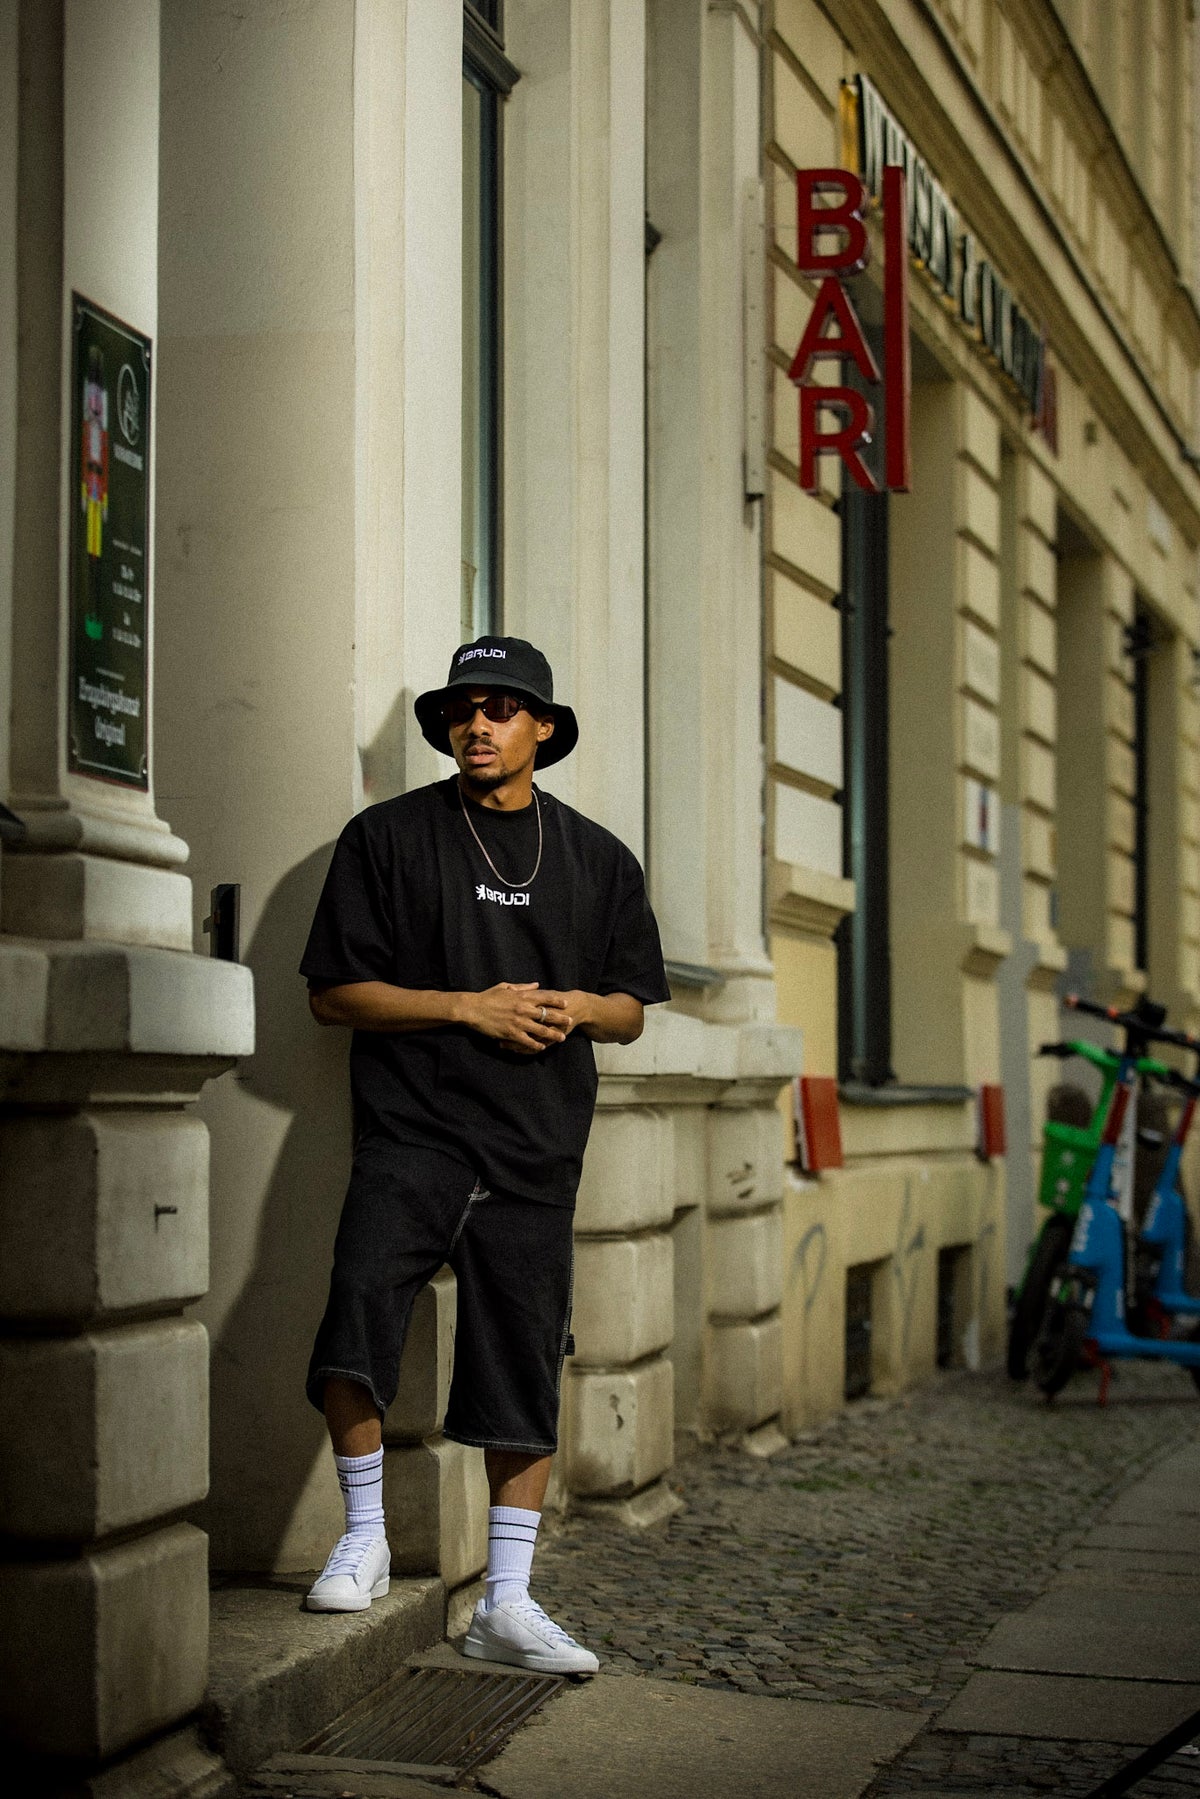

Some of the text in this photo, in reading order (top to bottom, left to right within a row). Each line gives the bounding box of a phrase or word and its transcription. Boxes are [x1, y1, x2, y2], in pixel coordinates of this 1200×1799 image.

[787, 168, 881, 495] BAR
[464, 648, 506, 660] BRUDI
[486, 887, 530, 906] BRUDI
